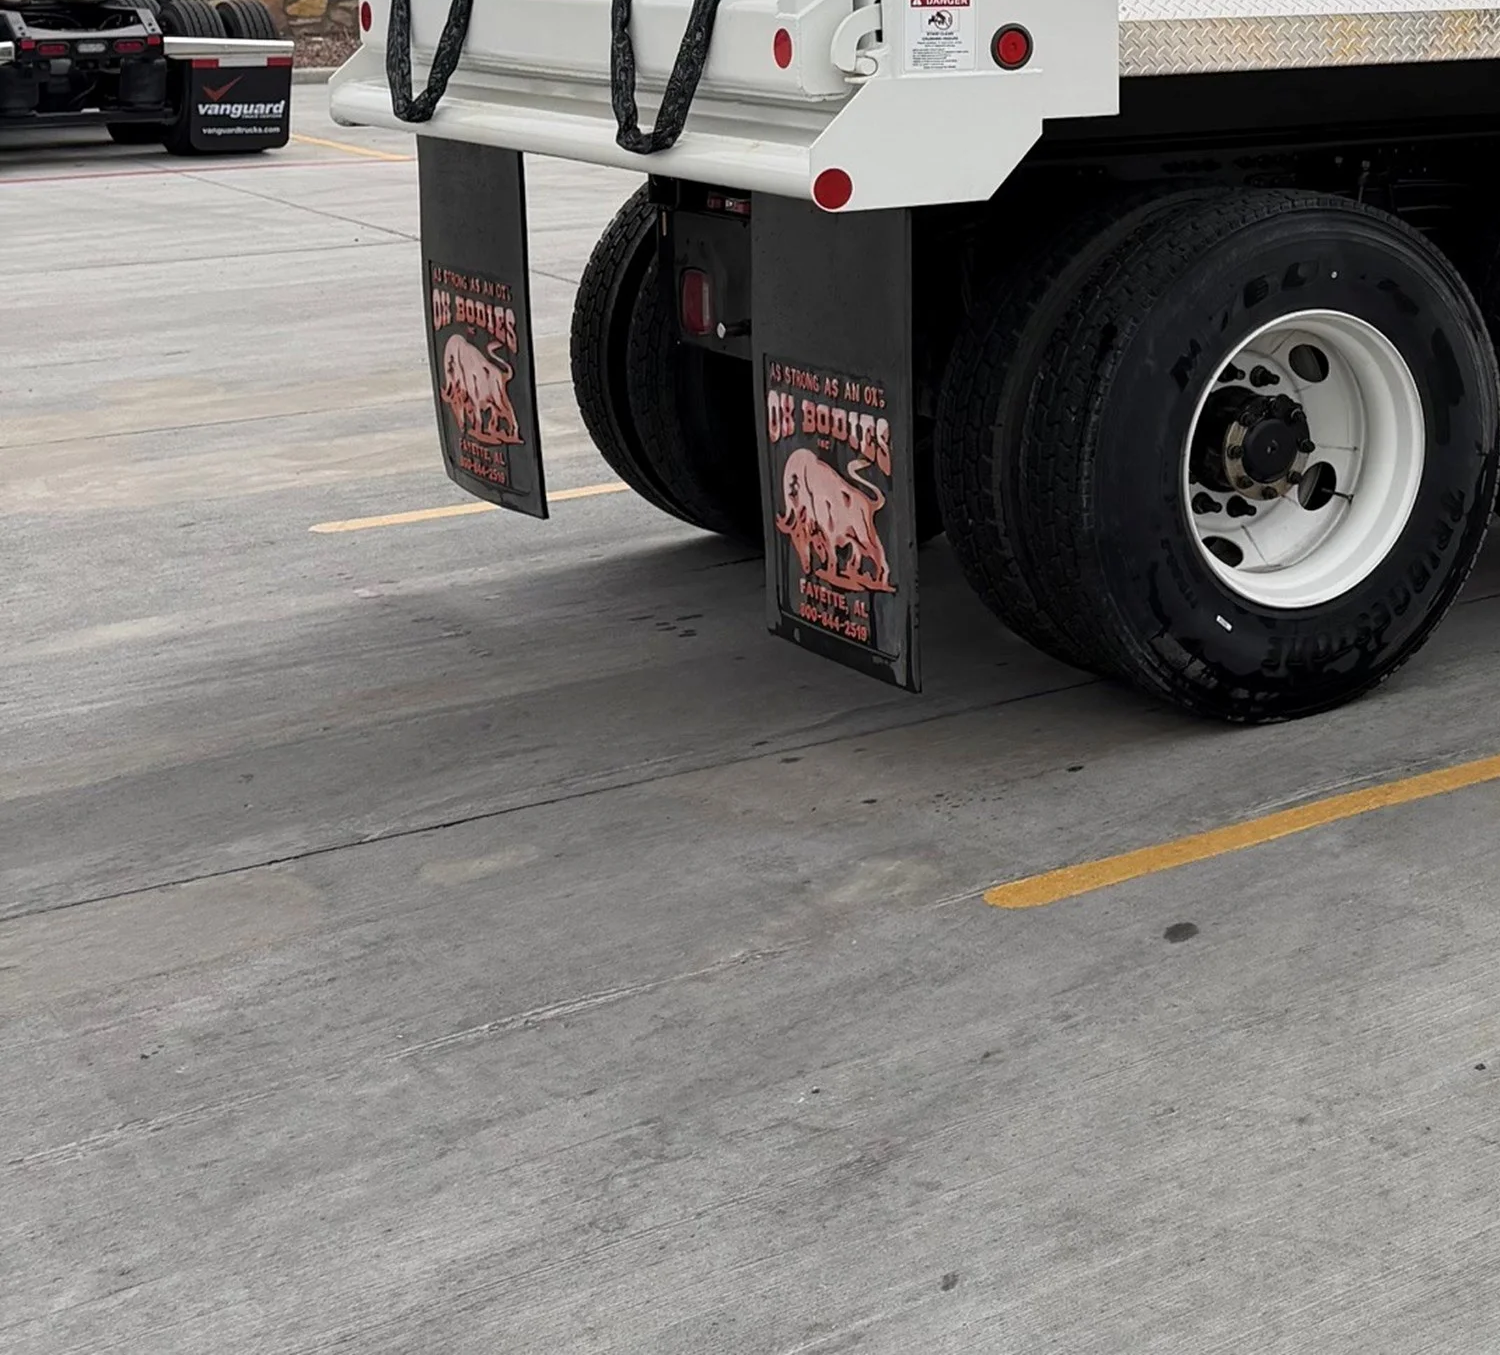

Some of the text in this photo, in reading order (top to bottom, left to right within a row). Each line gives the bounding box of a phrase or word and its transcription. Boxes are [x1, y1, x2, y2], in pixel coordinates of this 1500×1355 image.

[197, 100, 285, 118] vanguard
[202, 126, 280, 136] vanguardtrucks.com
[433, 288, 517, 354] OX BODIES
[770, 362, 781, 382] AS
[783, 366, 820, 393] STRONG
[824, 377, 839, 398] AS
[844, 382, 860, 403] AN
[768, 390, 891, 476] OX BODIES
[799, 577, 868, 618] FAYETTE, AL
[799, 602, 868, 642] 800-844-2519
